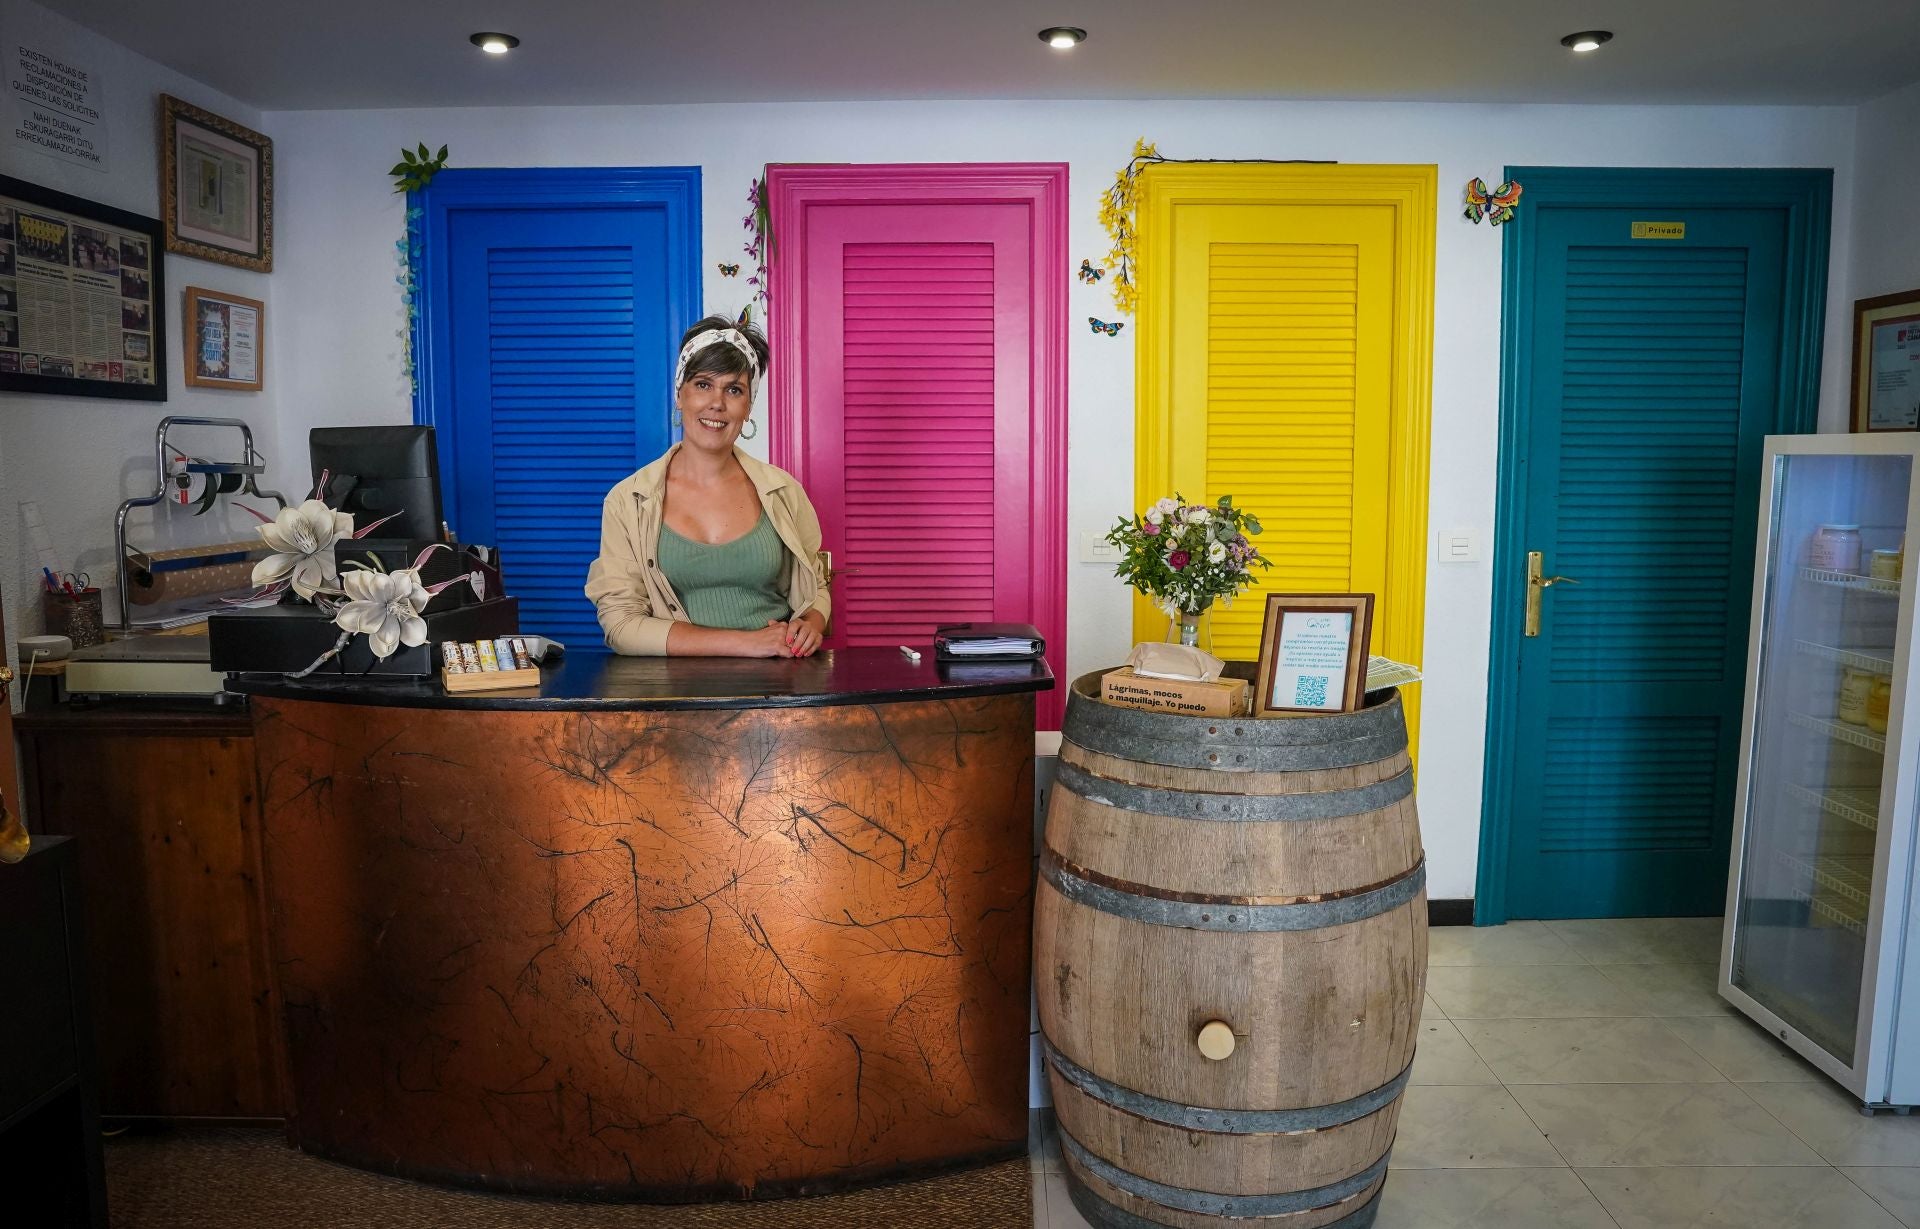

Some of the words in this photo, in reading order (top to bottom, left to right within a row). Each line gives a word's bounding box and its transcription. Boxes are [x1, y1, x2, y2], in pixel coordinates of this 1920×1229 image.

[19, 46, 53, 67] EXISTEN
[54, 62, 77, 78] HOJAS
[78, 71, 88, 82] DE
[20, 59, 82, 91] RECLAMACIONES
[83, 85, 88, 93] A
[12, 81, 47, 100] QUIENES
[48, 95, 62, 106] LAS
[62, 99, 100, 119] SOLICITEN
[73, 92, 84, 103] DE
[23, 119, 76, 145] ESKURAGARRI
[77, 136, 94, 150] DITU
[33, 111, 51, 124] NAHI
[52, 118, 82, 135] DUENAK
[15, 128, 101, 163] ERREKLAMAZIO-ORRIAK
[1648, 226, 1683, 234] Privado
[1109, 683, 1151, 696] Lágrimas,
[1153, 690, 1183, 699] mocos
[1115, 695, 1163, 707] maquillaje.
[1165, 700, 1176, 708] Yo
[1177, 701, 1206, 712] puedo
